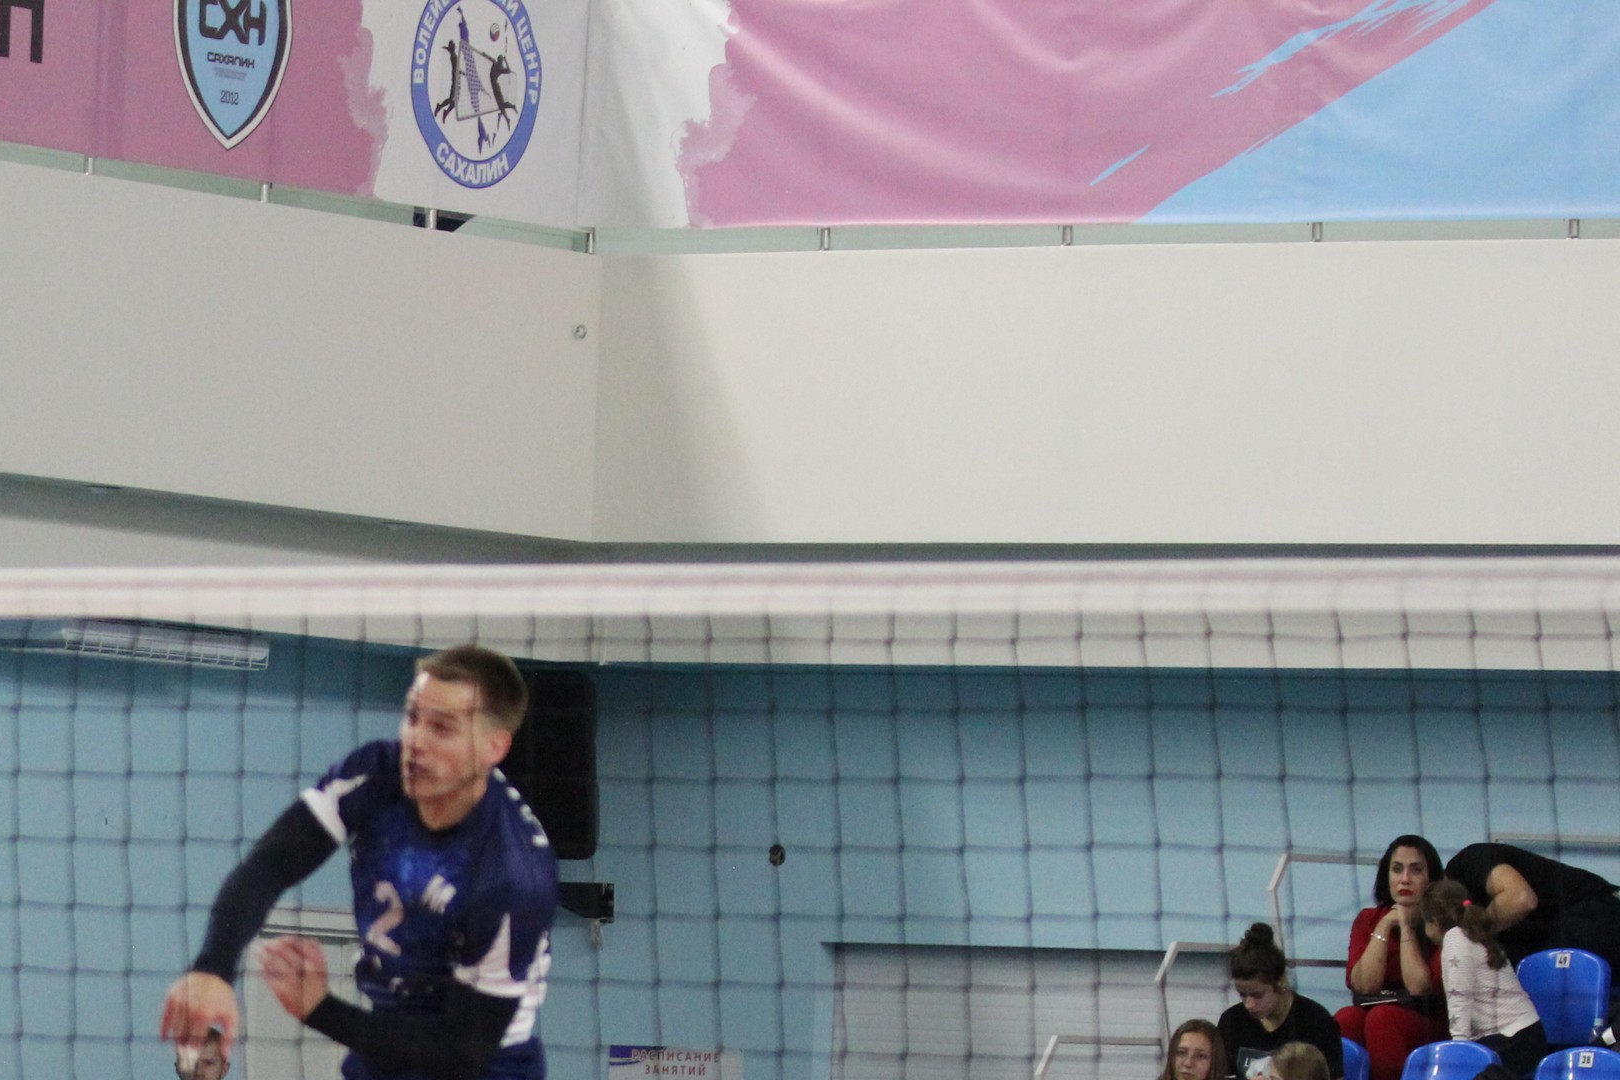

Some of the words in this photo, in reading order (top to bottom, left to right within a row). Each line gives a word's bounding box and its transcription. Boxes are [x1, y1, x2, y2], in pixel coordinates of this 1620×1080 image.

[220, 89, 240, 105] 2012
[436, 142, 510, 184] САХАЛИН
[366, 880, 404, 957] 2
[1558, 956, 1568, 965] 49
[631, 1049, 721, 1063] РАСПИСАНИЕ
[644, 1064, 706, 1076] ЗАНЯТИЙ
